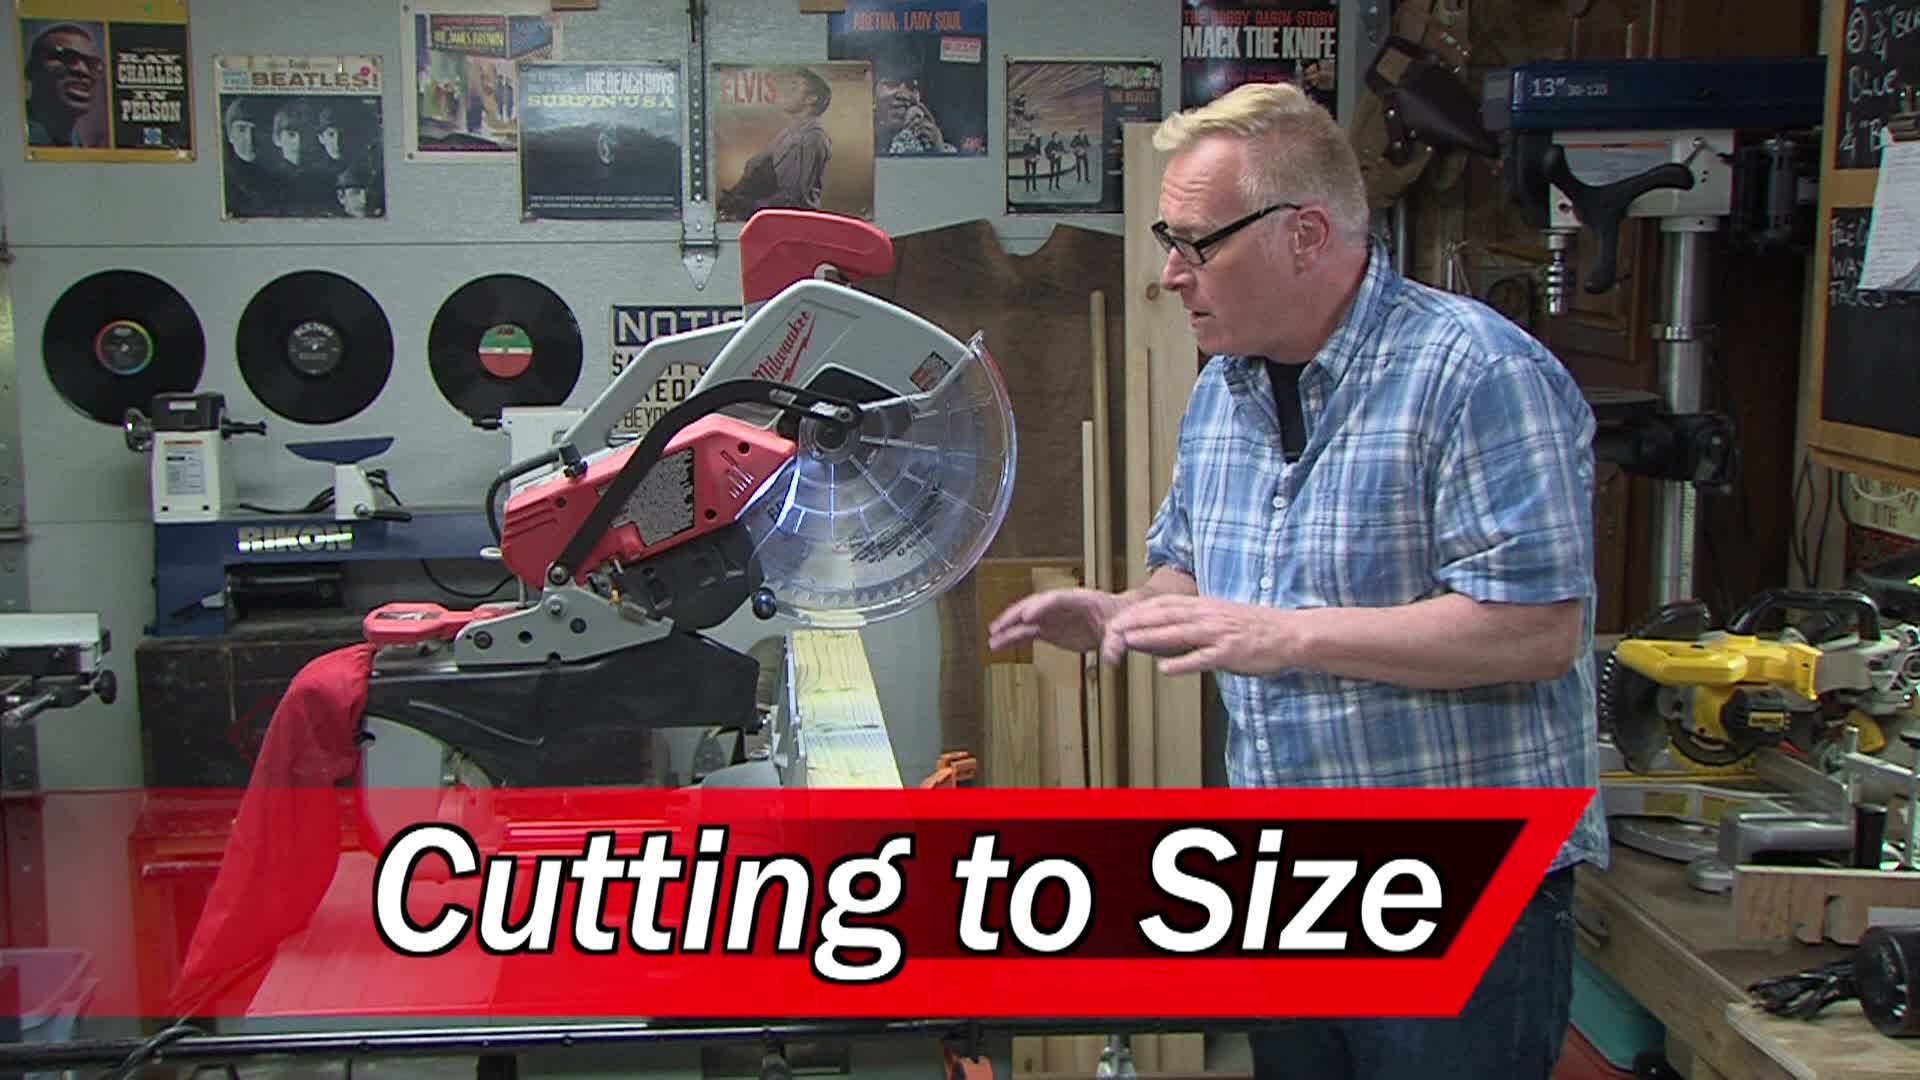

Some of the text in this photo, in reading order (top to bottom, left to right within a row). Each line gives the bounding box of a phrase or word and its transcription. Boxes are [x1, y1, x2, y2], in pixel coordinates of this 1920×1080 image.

[1296, 11, 1336, 26] STORY
[1183, 26, 1336, 59] MACK THE KNIFE
[118, 64, 183, 84] CHARLES
[720, 71, 778, 104] ELVIS
[121, 100, 181, 121] PERSON
[751, 310, 810, 380] Milwaukee
[238, 524, 352, 552] RIKON
